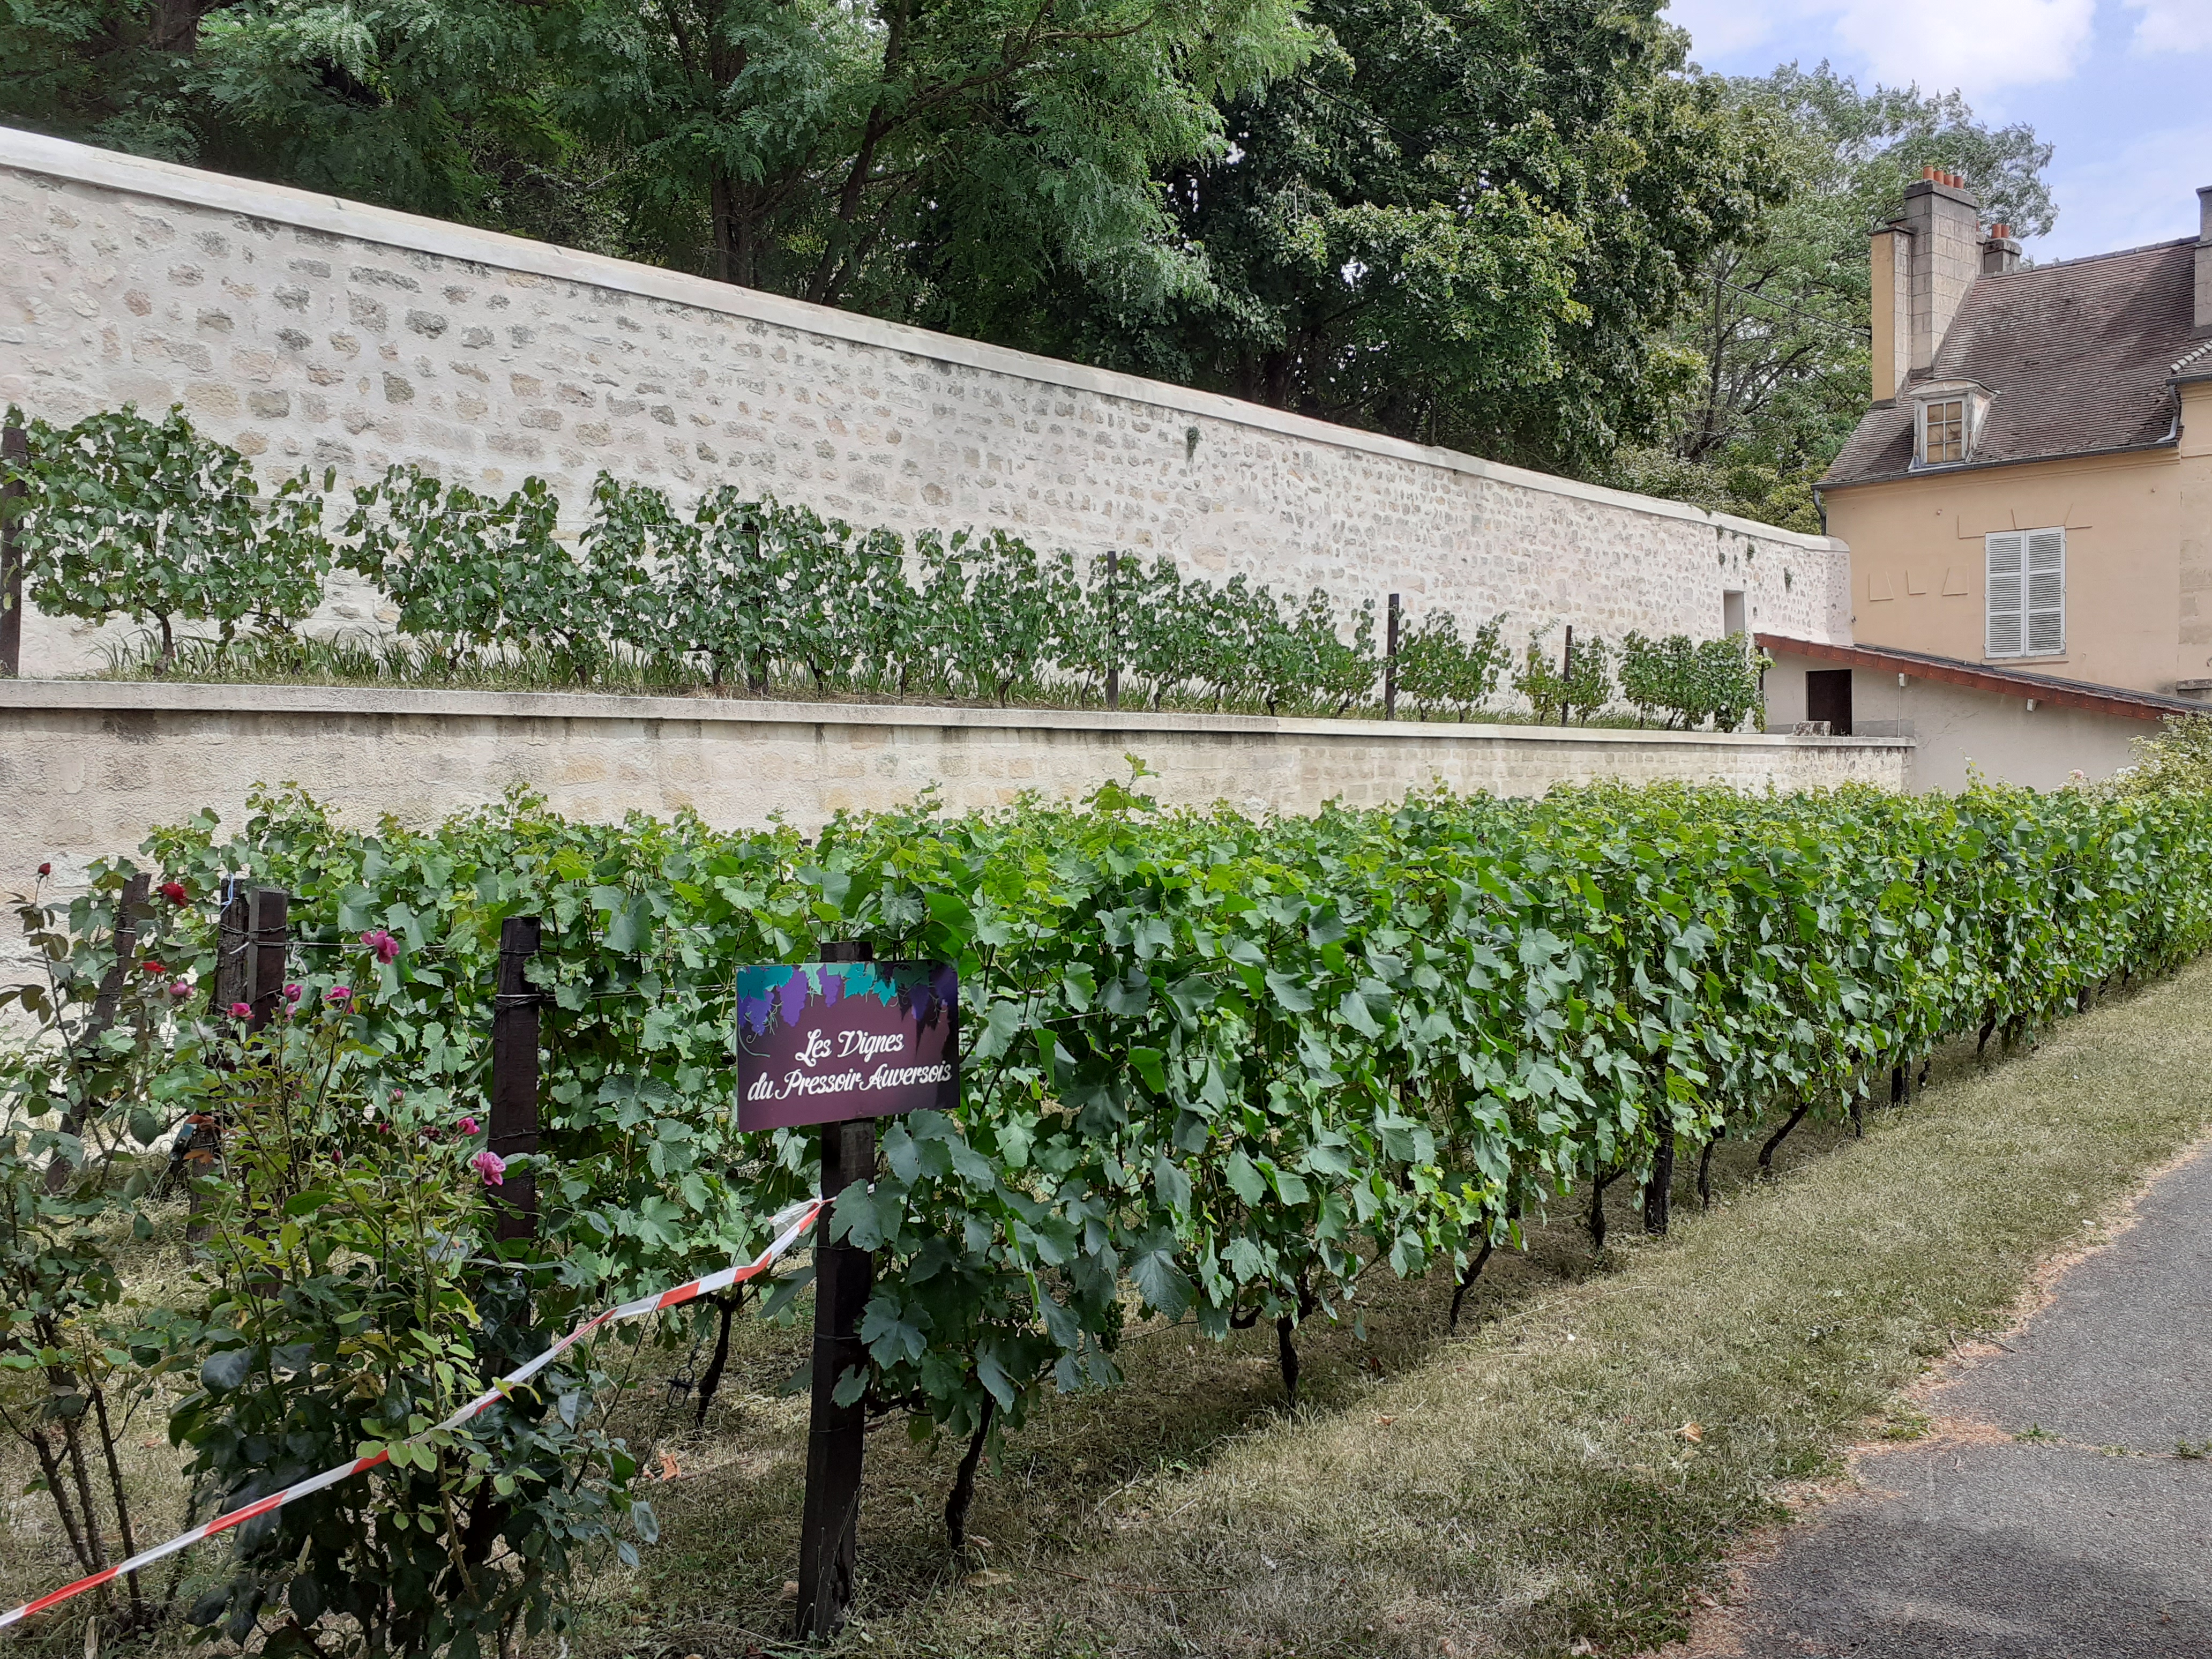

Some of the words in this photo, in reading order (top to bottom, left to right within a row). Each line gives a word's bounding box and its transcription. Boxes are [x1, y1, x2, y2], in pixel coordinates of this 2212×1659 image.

[795, 1029, 832, 1067] Les
[837, 1030, 905, 1063] Vignes
[747, 1072, 774, 1101] du
[774, 1068, 861, 1100] Pressoir
[860, 1060, 952, 1090] Auversois
